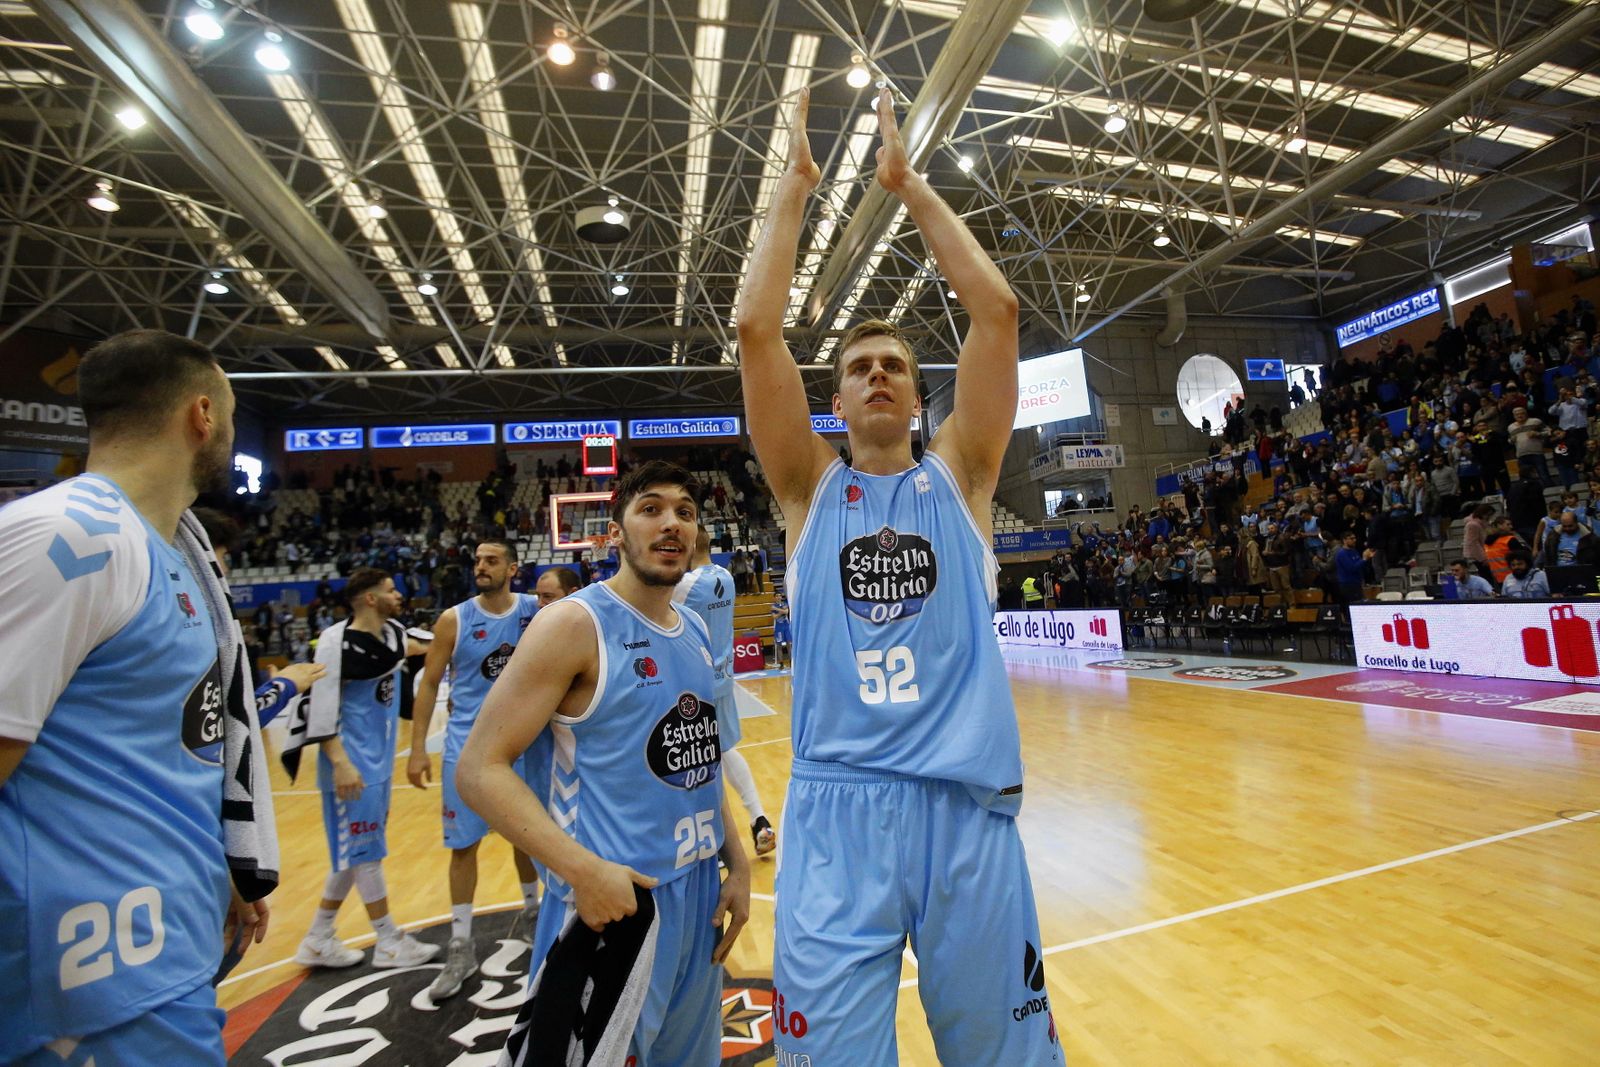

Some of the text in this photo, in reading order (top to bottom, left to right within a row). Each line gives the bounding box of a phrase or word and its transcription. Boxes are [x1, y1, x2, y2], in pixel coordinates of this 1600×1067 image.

[1340, 288, 1437, 340] NEUMÁTICOS REY
[1019, 378, 1070, 397] FORZA
[0, 398, 88, 427] ANDE
[1020, 393, 1060, 410] BREO
[414, 431, 469, 443] CANDELAS
[635, 421, 720, 435] Estrella Galicia
[810, 418, 843, 429] OTOR
[1075, 448, 1104, 458] LEYMA
[846, 545, 931, 575] Estrella
[849, 571, 927, 600] Galicia
[1024, 614, 1039, 638] de
[1042, 617, 1075, 646] Lugo
[623, 639, 651, 650] hummel
[856, 646, 920, 705] 52
[1364, 654, 1460, 673] Concello de Lugo
[662, 716, 719, 748] Estrella
[674, 809, 718, 870] 25
[57, 886, 165, 991] 20
[1013, 995, 1049, 1021] CANDE
